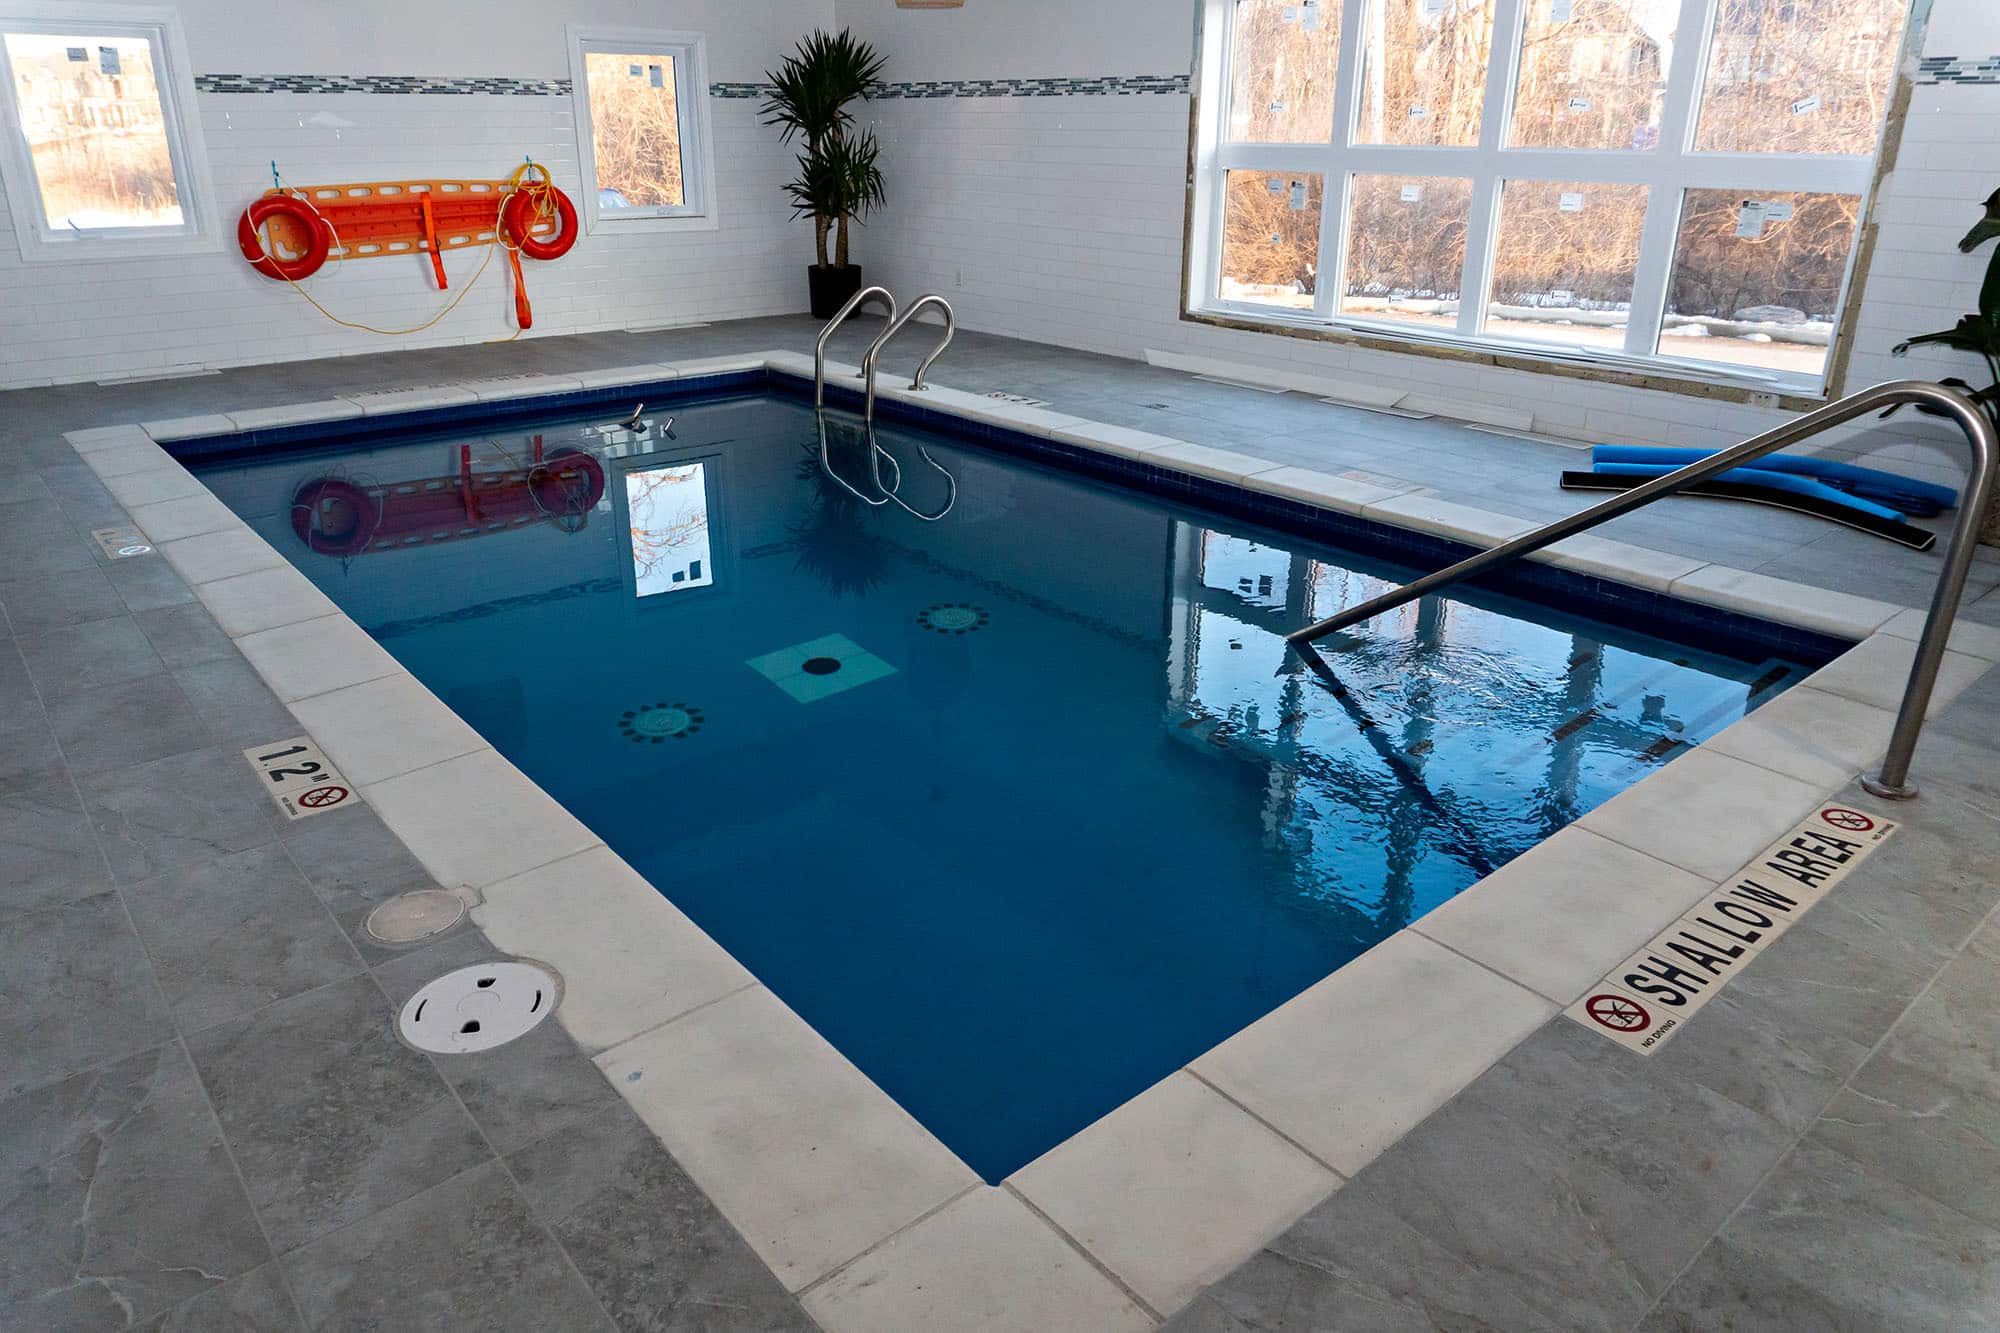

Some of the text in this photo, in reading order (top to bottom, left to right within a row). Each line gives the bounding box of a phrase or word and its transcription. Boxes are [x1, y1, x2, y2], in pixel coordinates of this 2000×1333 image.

[1624, 830, 1862, 1007] SHALLOW AREA
[1641, 1019, 1677, 1048] NO DIVING
